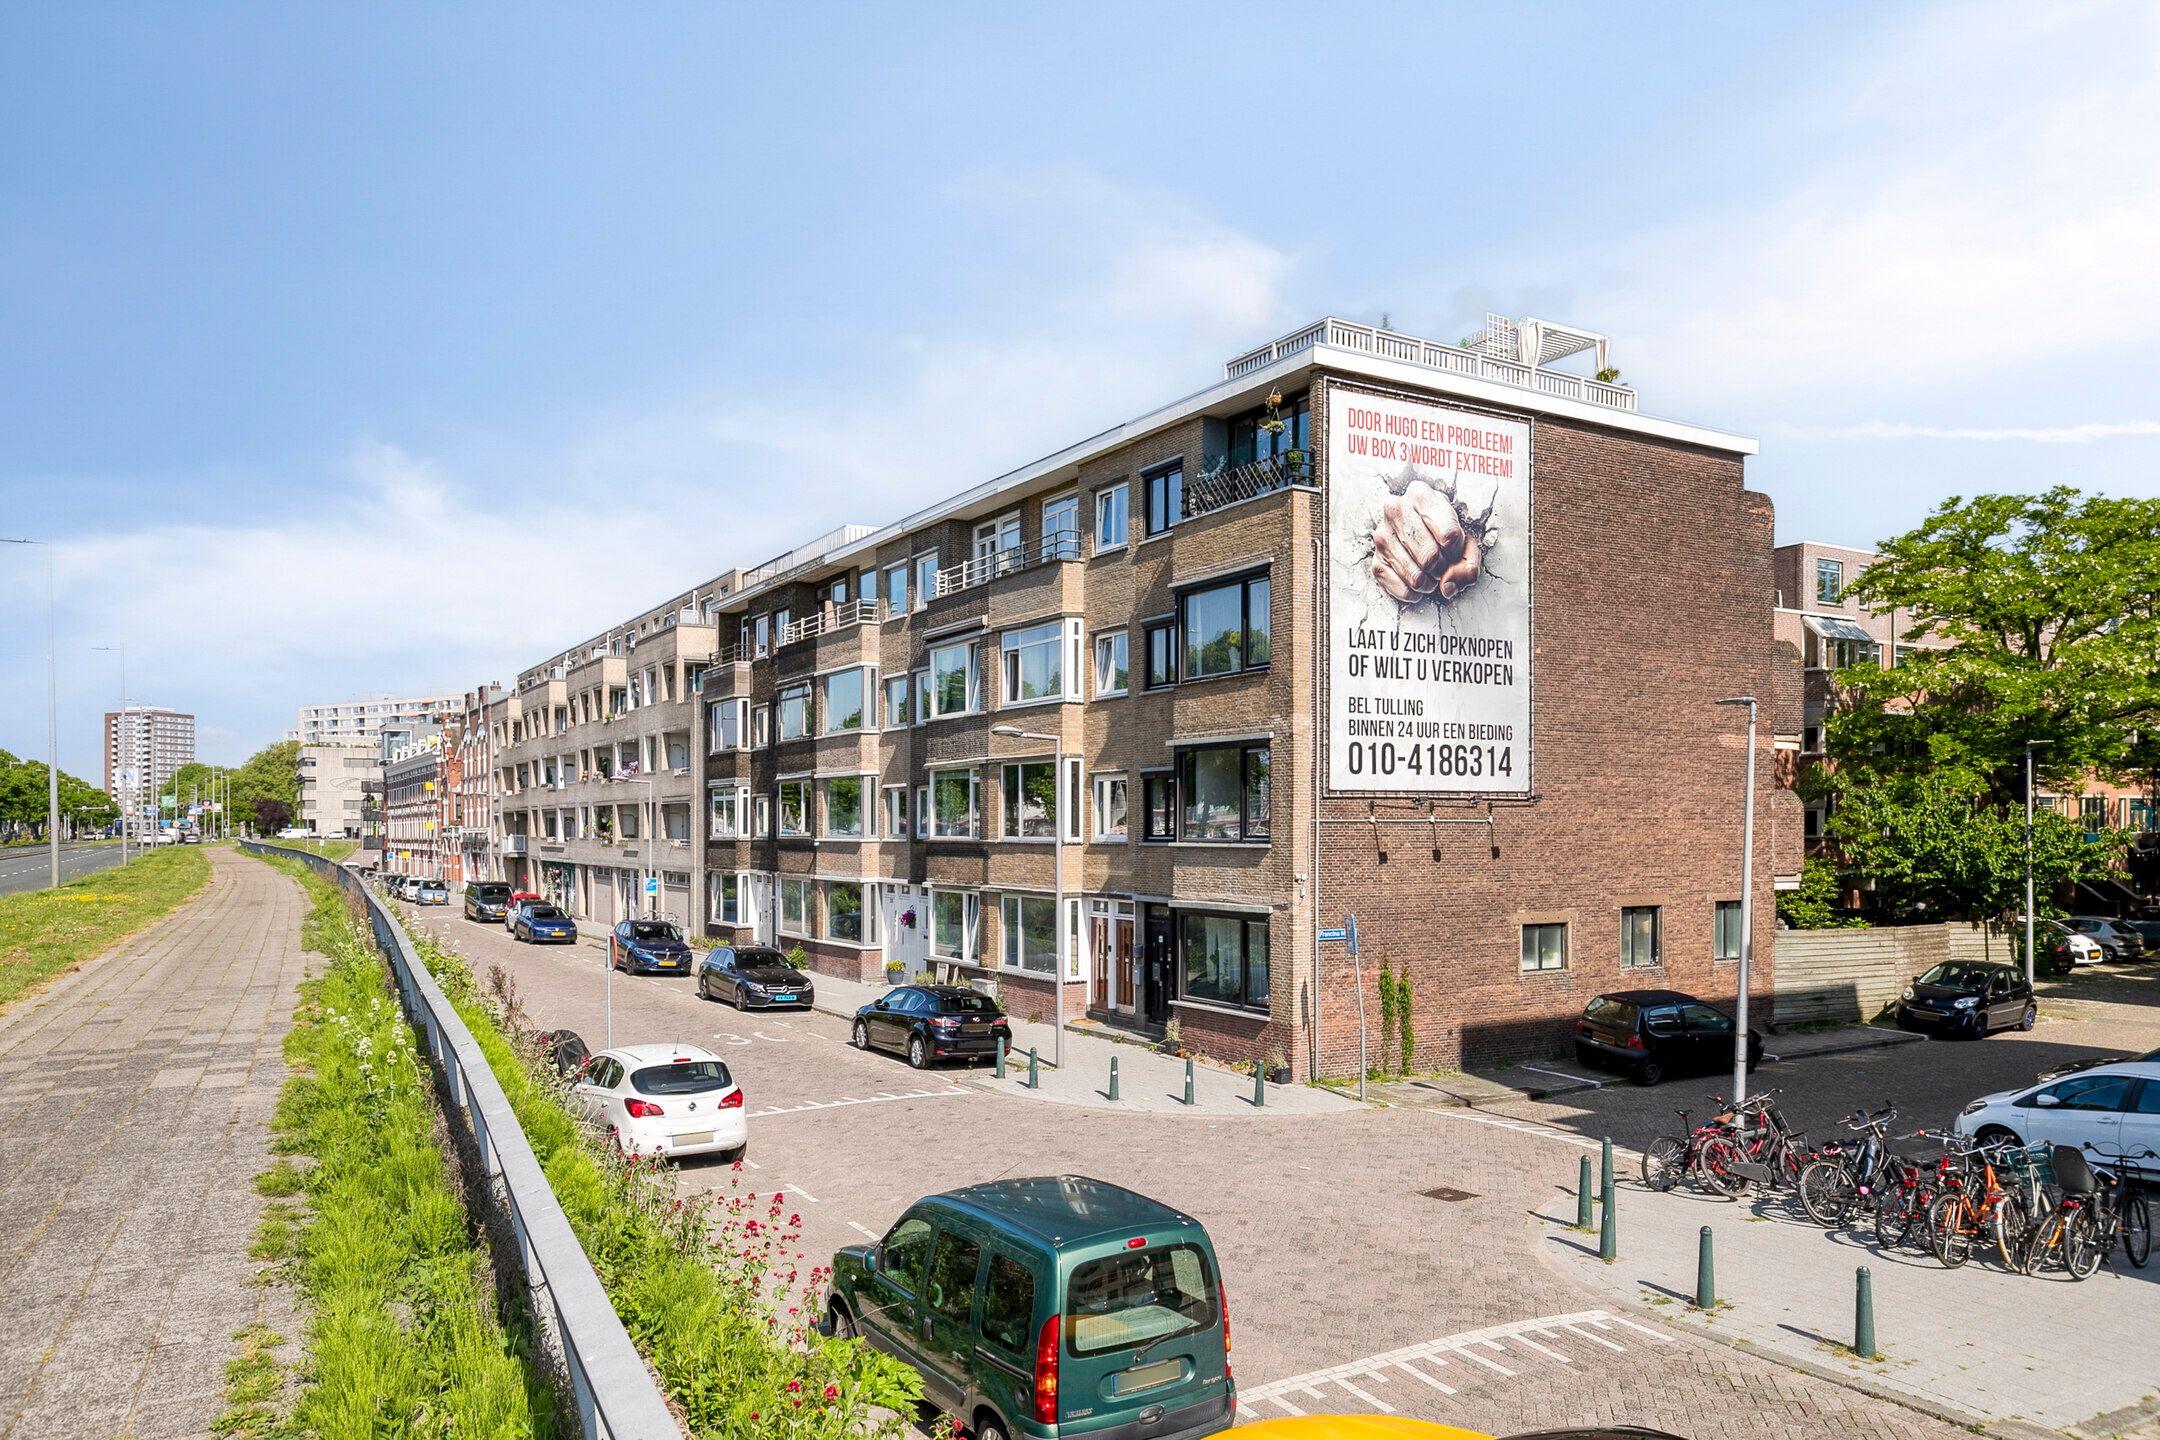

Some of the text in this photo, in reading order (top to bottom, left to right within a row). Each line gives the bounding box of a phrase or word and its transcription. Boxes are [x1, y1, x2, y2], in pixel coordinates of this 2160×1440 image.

[1348, 407, 1513, 454] DOOR HUGO EEN PROBLEEM!
[1348, 433, 1513, 478] UW BOX 3 WORDT EXTREEM!
[1349, 628, 1513, 660] LAAT U ZICH OPKNOPEN
[1349, 654, 1513, 686] OF WILT U VERKOPEN
[1348, 696, 1424, 717] BEL TULLING
[1348, 719, 1513, 741] BINNEN 24 UUR EEN BIEDING
[1348, 741, 1513, 777] 010-4186314
